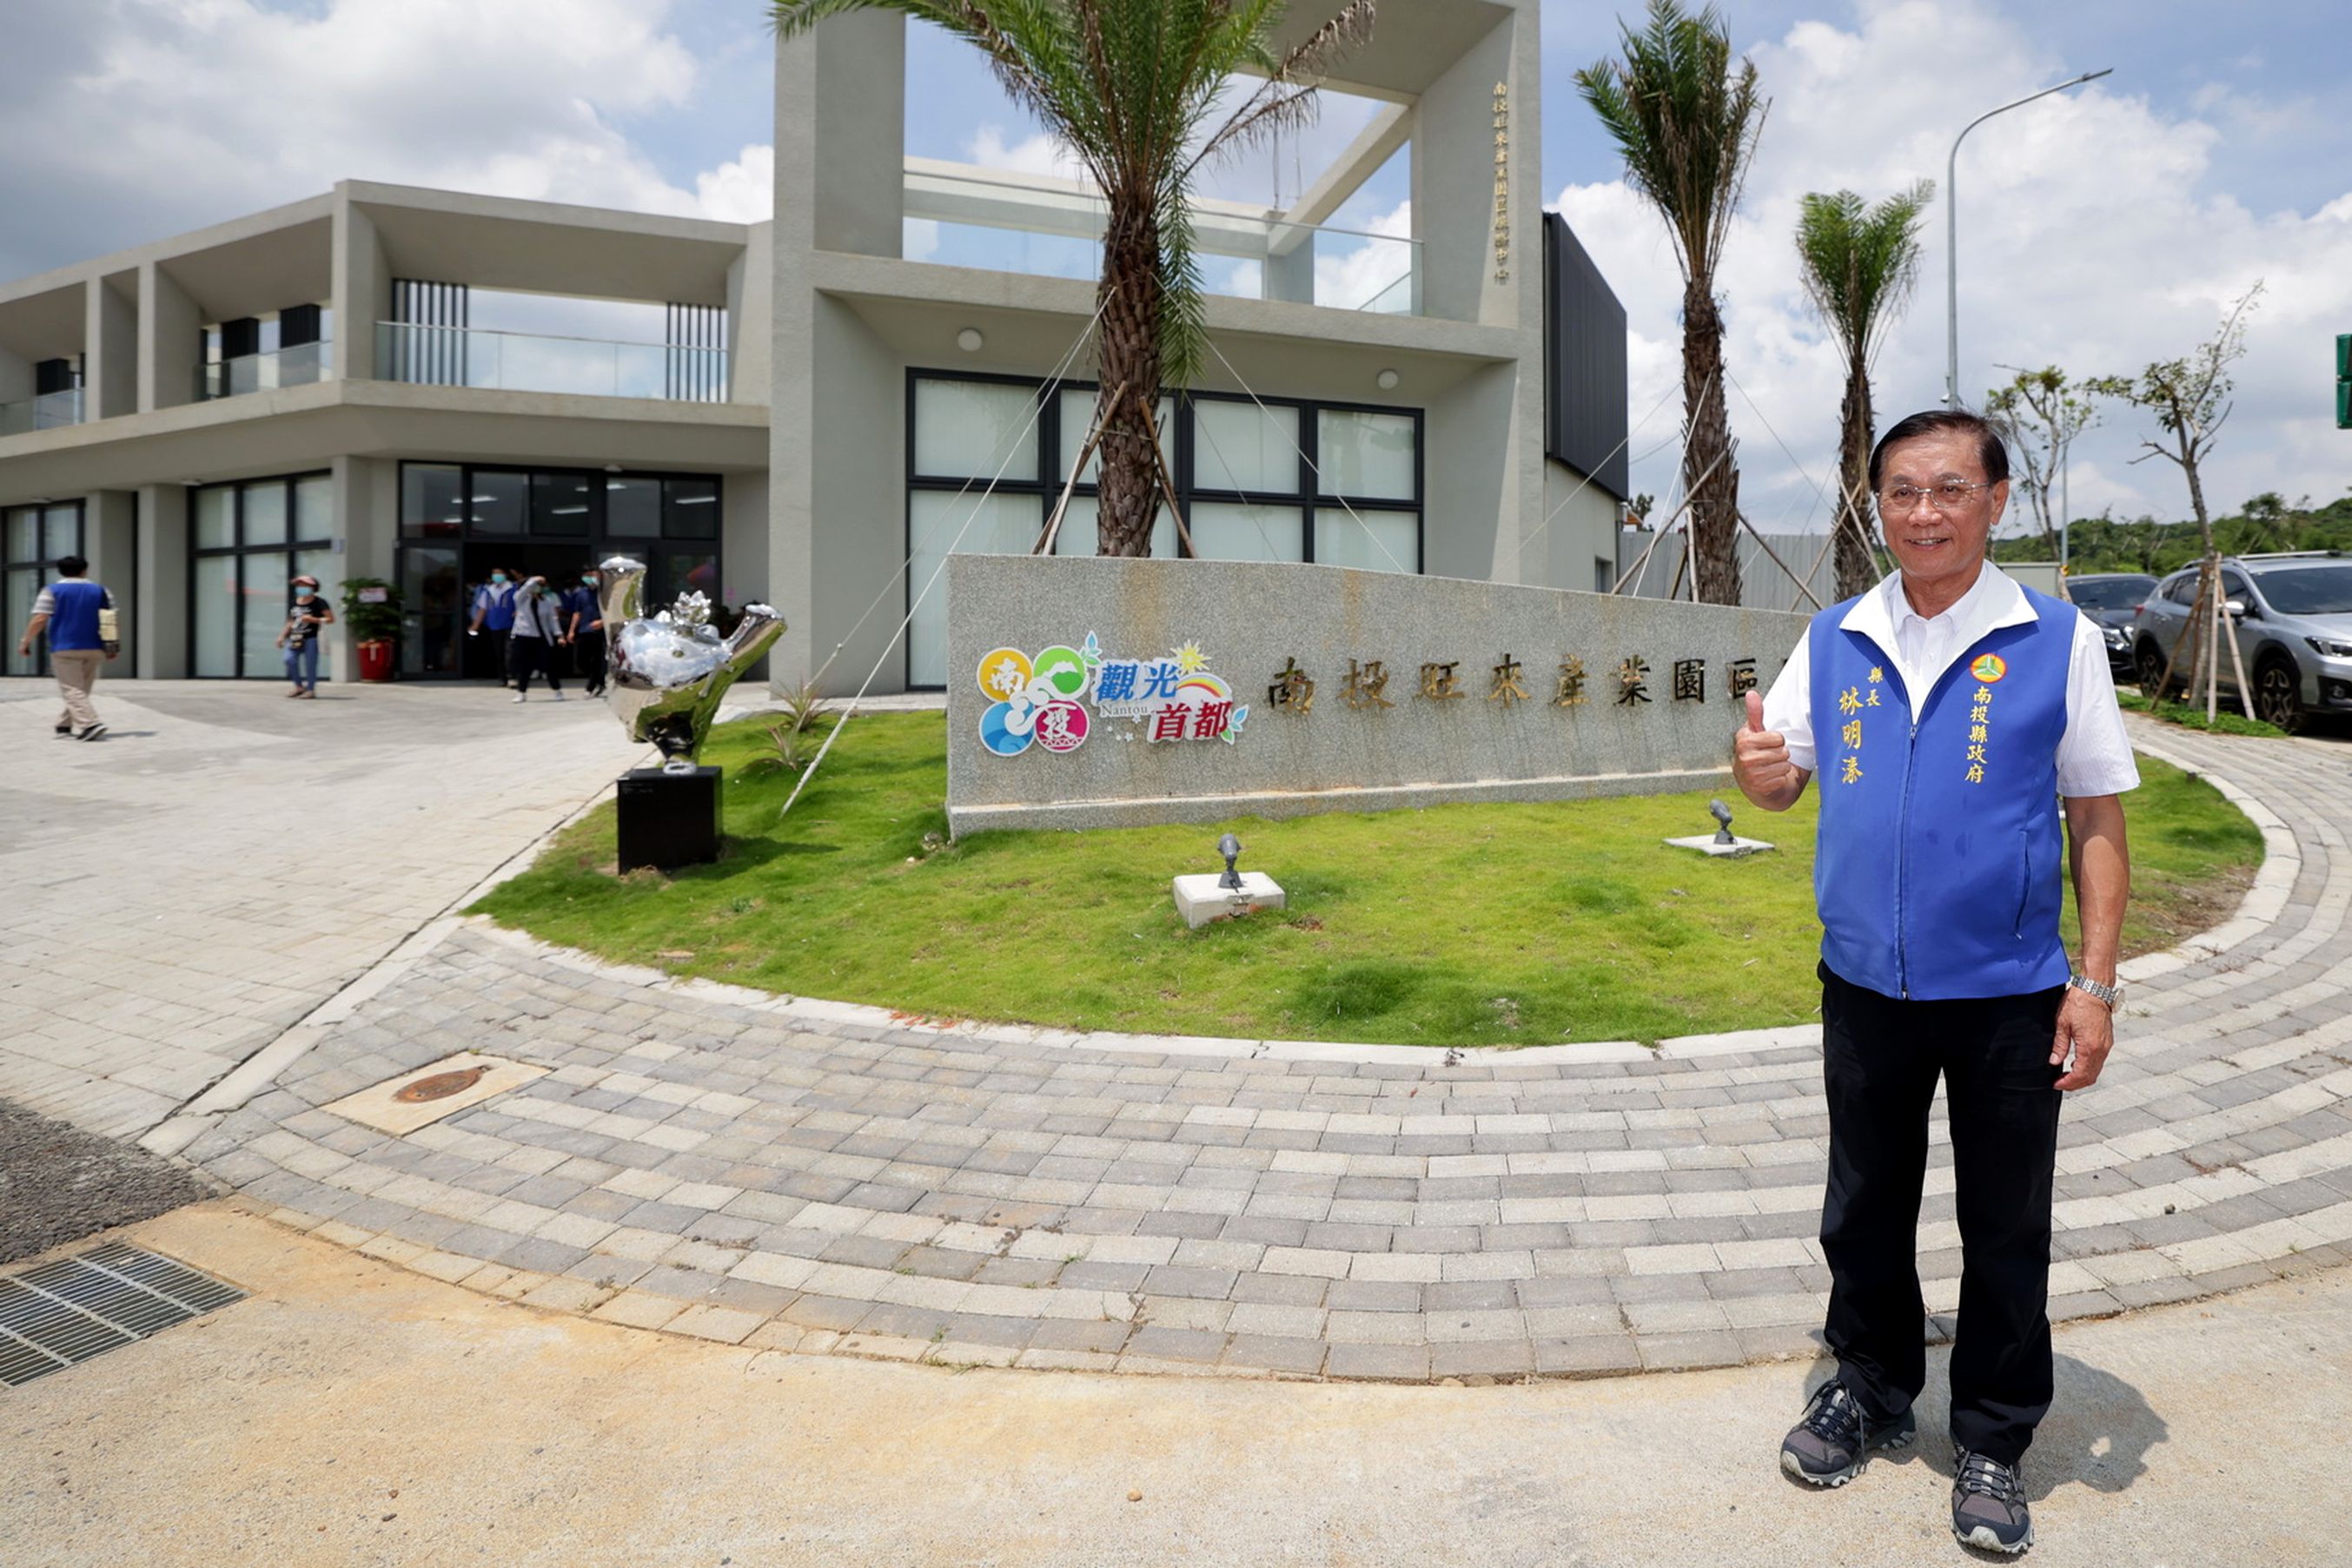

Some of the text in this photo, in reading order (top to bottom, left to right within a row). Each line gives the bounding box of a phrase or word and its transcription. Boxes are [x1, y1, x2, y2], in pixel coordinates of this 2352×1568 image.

[1096, 663, 1180, 702] 觀光
[1269, 653, 1788, 715] 南投旺來產業園區
[1865, 666, 1884, 706] 縣長
[1100, 705, 1148, 716] Nantou
[1154, 699, 1233, 739] 首都
[1839, 685, 1864, 785] 林明溱
[1964, 685, 1993, 784] 南投縣政府
